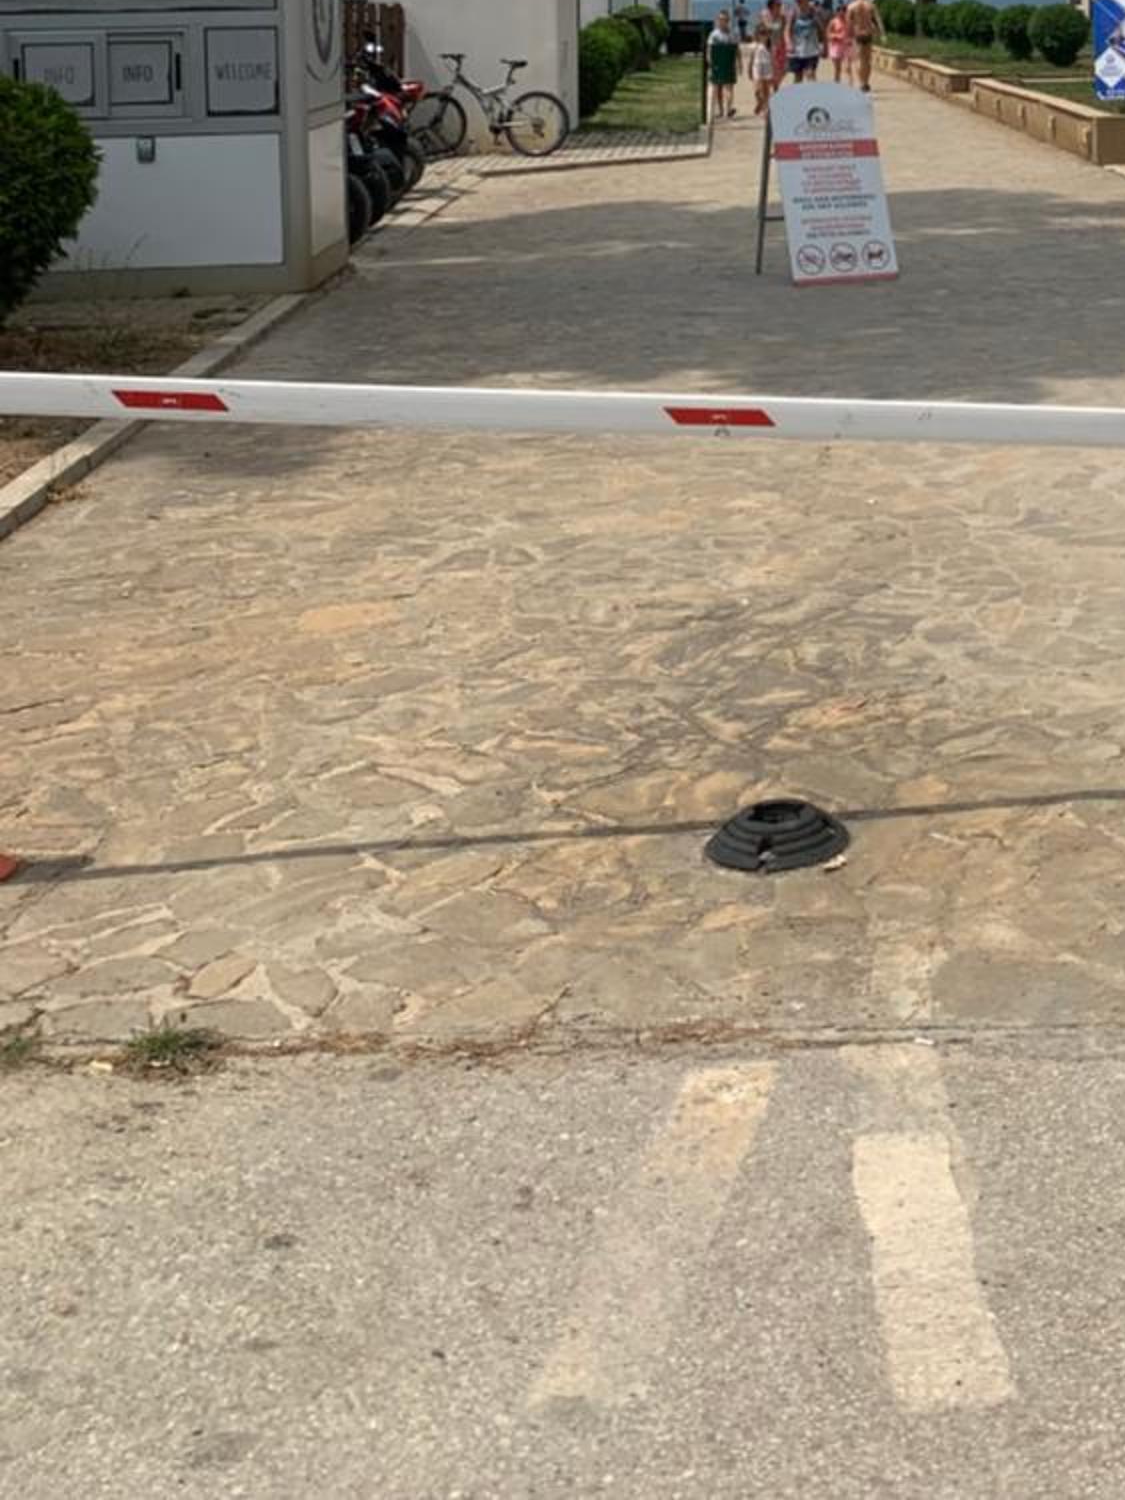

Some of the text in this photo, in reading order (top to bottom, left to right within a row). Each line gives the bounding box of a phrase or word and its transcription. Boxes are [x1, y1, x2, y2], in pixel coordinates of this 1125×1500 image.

[44, 67, 75, 84] INFO
[122, 64, 154, 83] INFO
[215, 62, 272, 81] WELCOME
